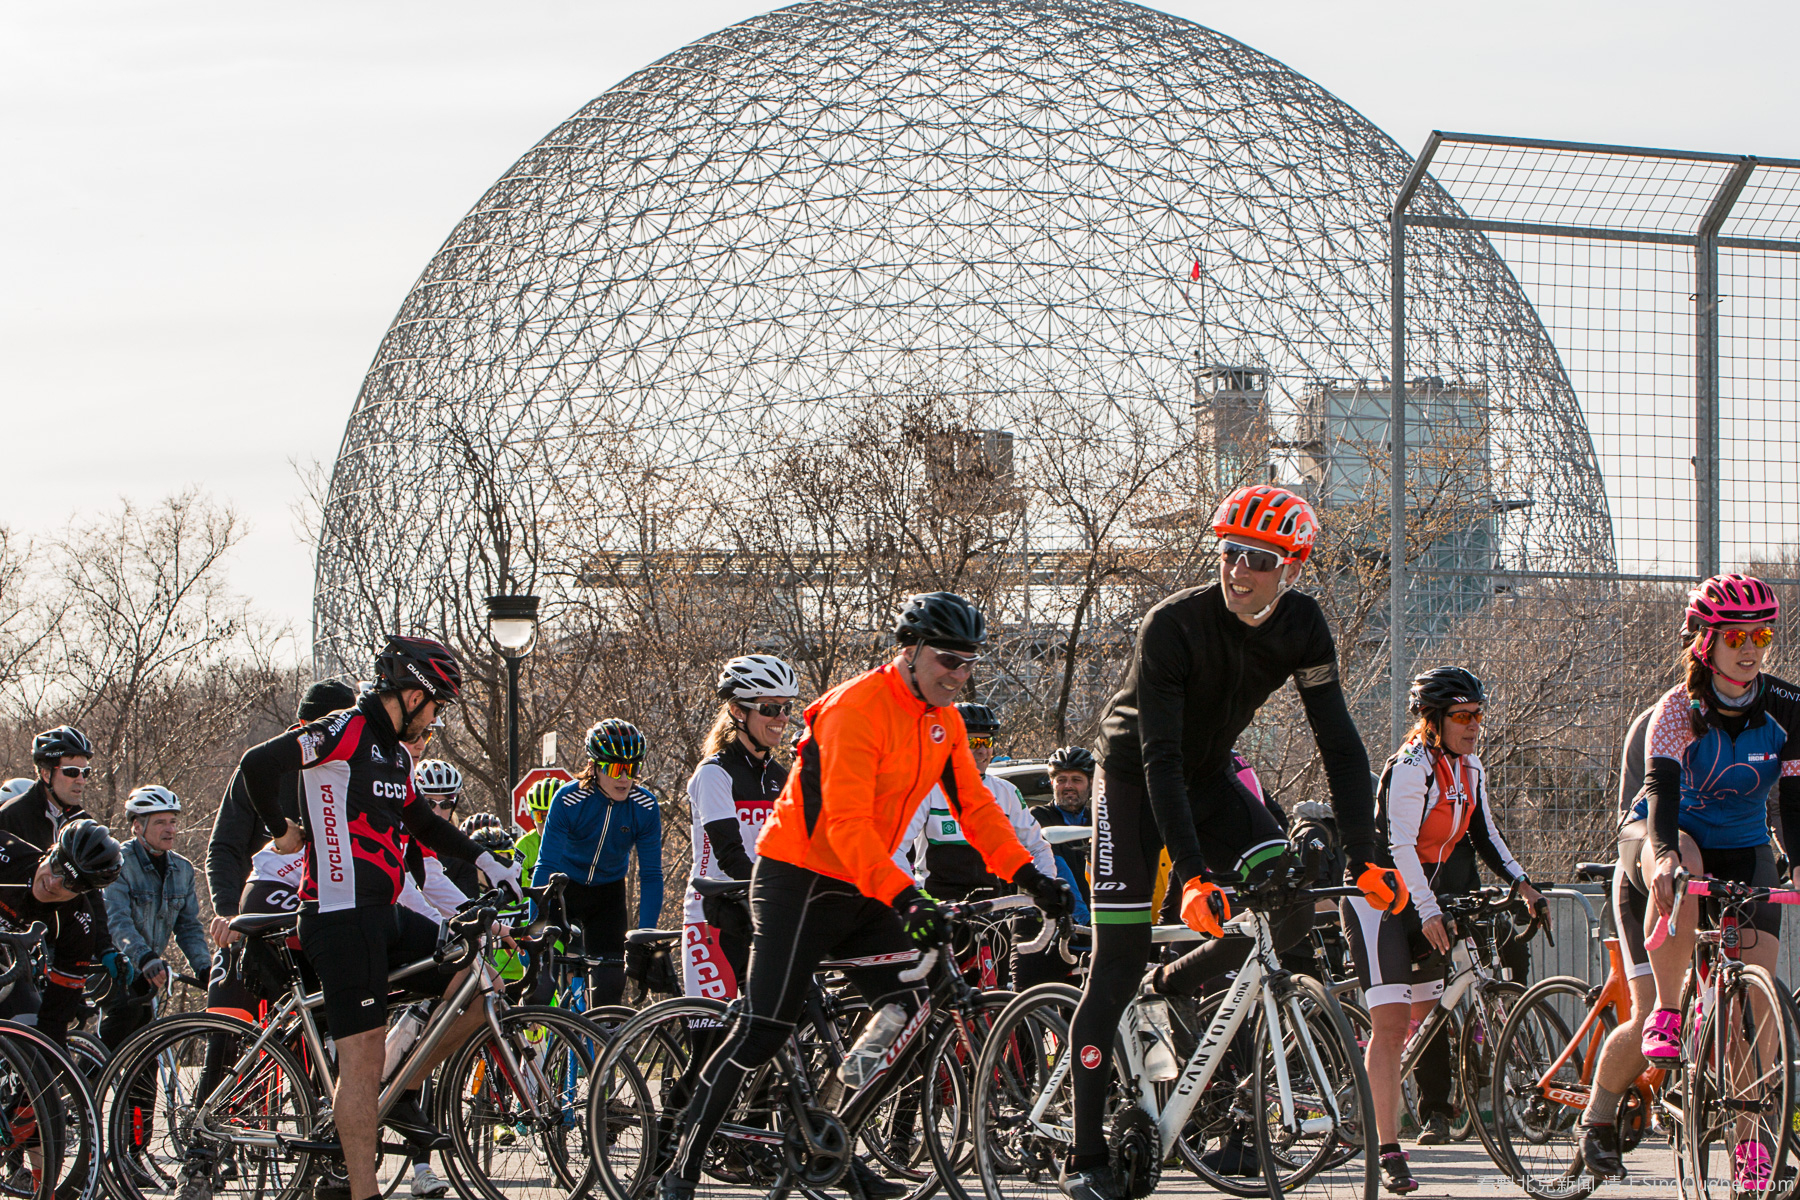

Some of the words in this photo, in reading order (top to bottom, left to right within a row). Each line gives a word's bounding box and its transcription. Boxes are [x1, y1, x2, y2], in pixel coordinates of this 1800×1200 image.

[406, 663, 437, 696] DIADORA
[1769, 684, 1800, 702] MONT
[328, 712, 351, 737] SUAREZ
[320, 784, 344, 883] CYCLEPOP.CA
[1097, 778, 1116, 876] momentum
[63, 861, 79, 879] RAPHA
[686, 924, 727, 999] CCCP
[886, 1001, 931, 1066] TIME
[1178, 981, 1251, 1097] CANYON.COM
[1044, 1052, 1071, 1095] CANYO
